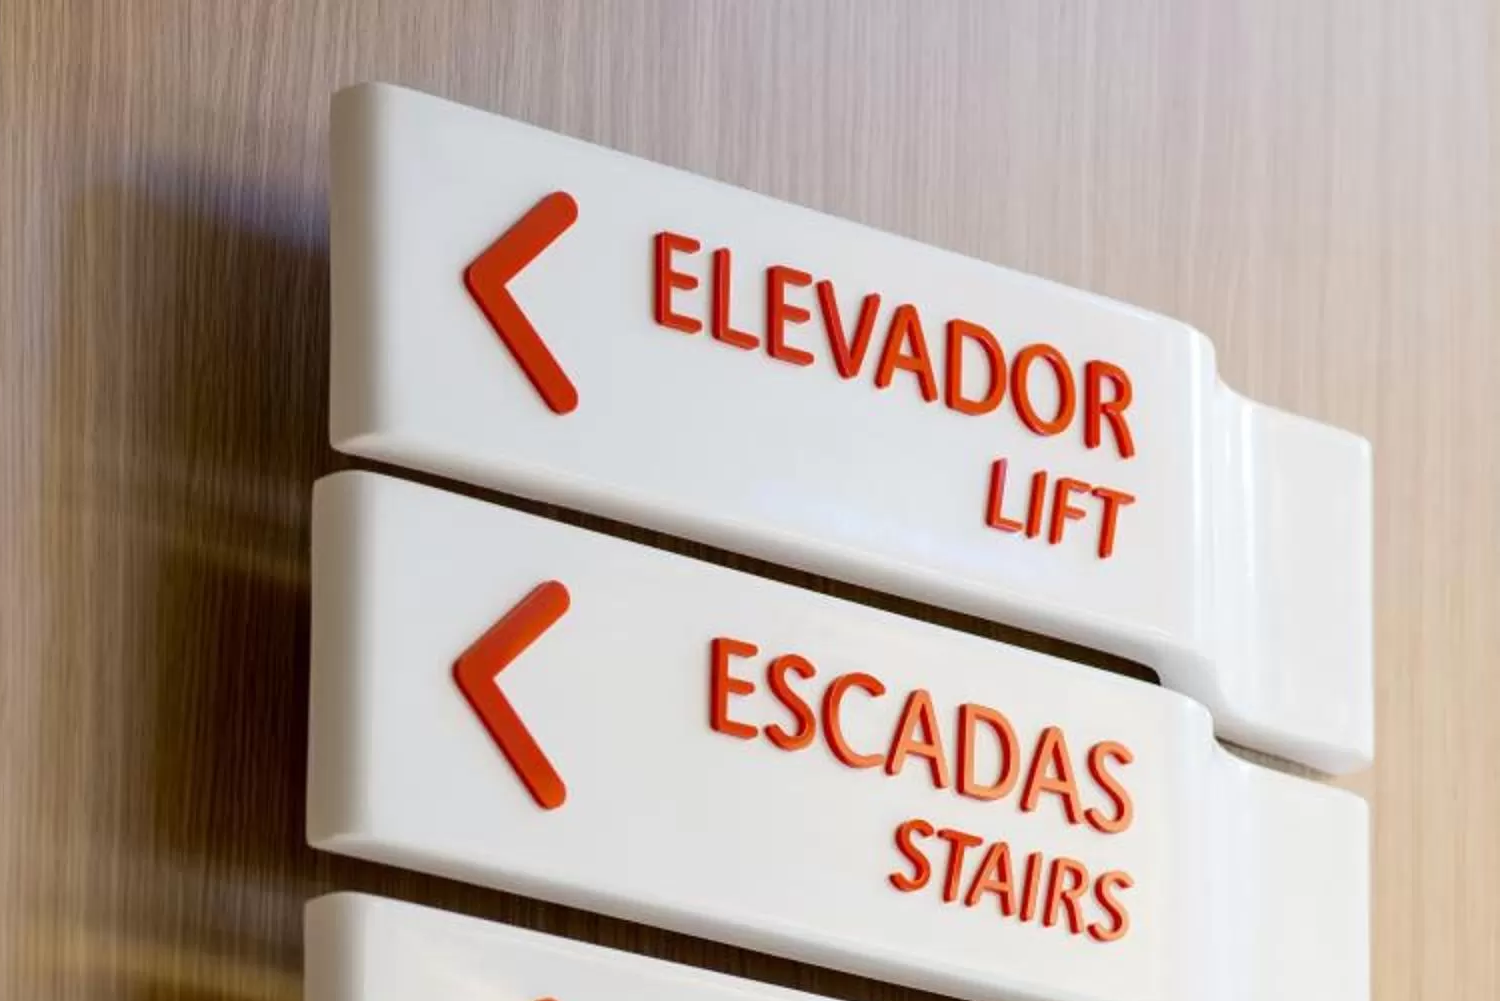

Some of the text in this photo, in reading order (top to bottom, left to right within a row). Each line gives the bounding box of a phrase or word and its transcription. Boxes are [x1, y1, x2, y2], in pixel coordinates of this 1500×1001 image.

[652, 230, 1136, 460] ELEVADOR
[984, 459, 1135, 560] LIFT
[708, 637, 1134, 834] ESCADAS
[888, 818, 1133, 942] STAIRS
